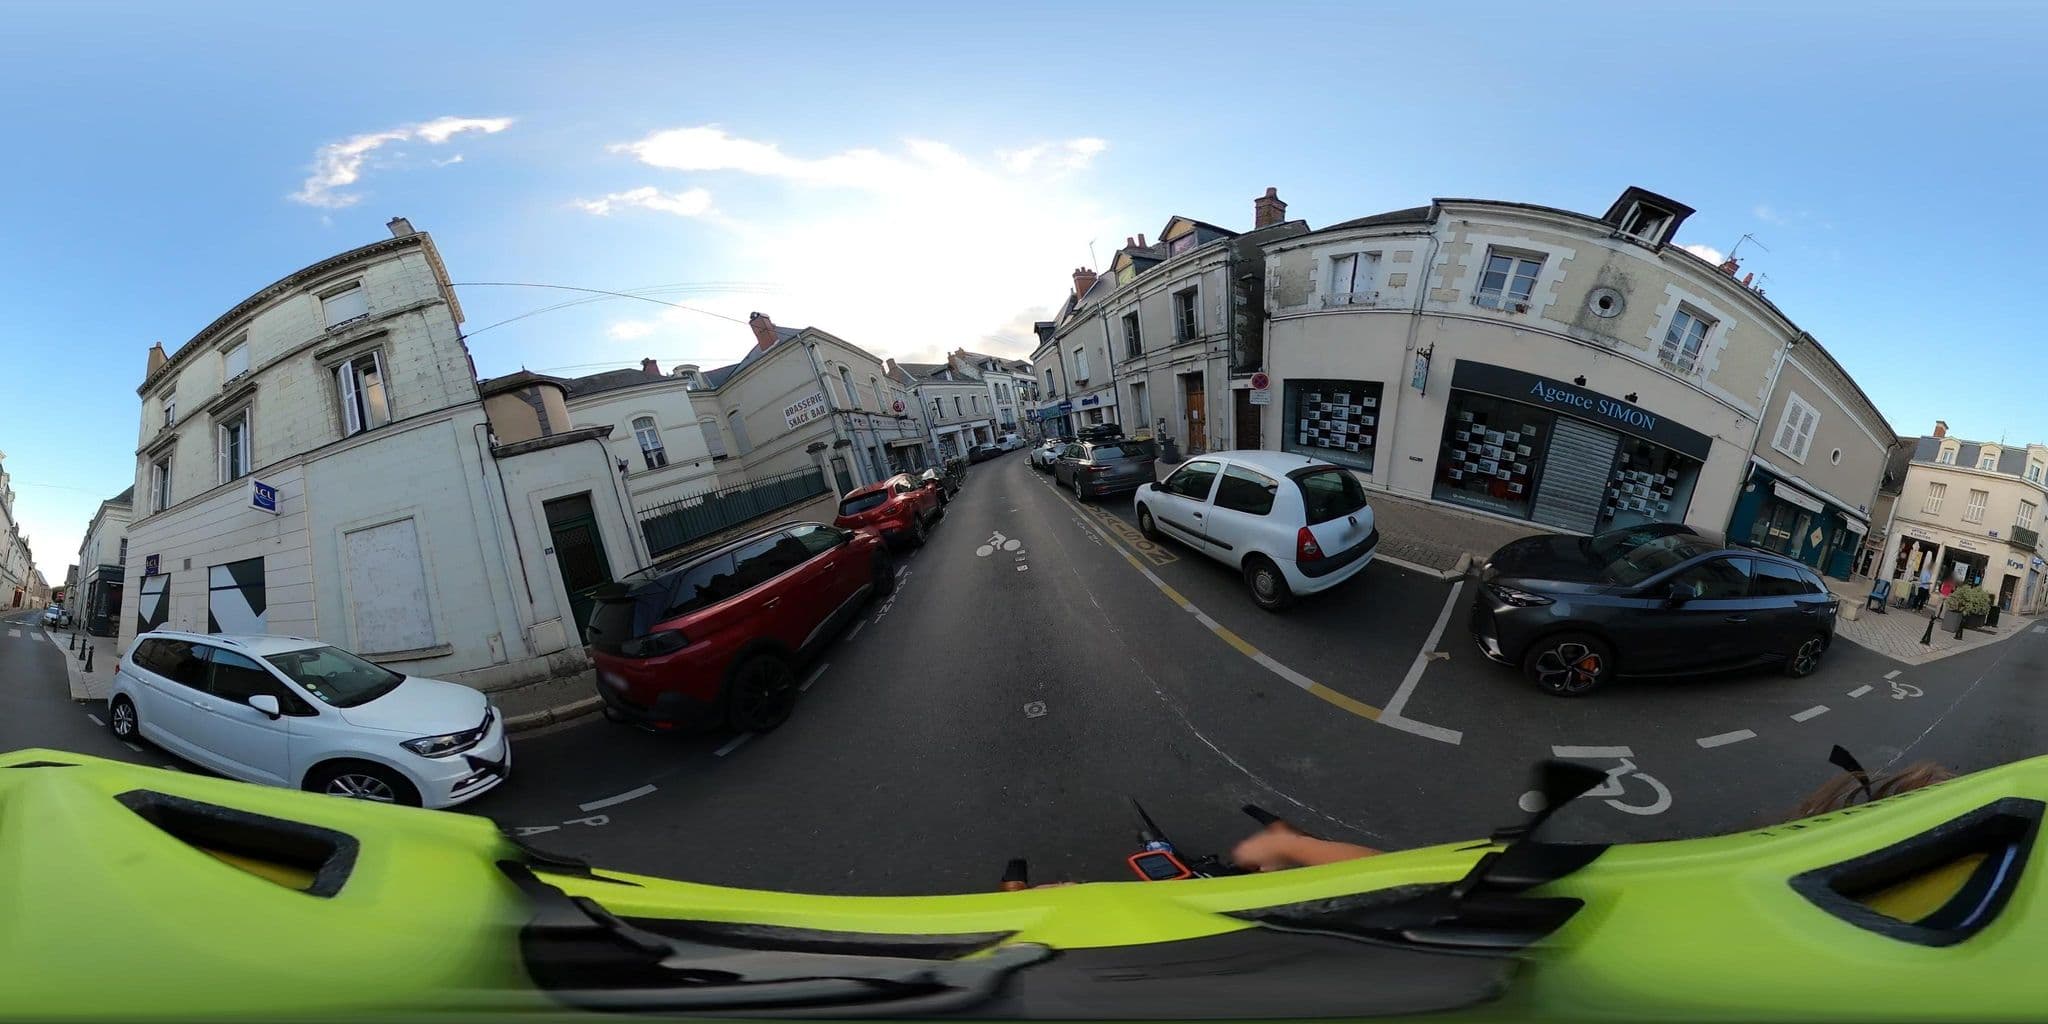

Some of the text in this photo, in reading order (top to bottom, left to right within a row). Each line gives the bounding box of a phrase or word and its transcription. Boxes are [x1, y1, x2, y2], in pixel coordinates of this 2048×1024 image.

[785, 392, 823, 417] BRASSERIE
[1530, 381, 1656, 431] Agence SIMON
[789, 405, 826, 429] SNACK BAR
[255, 486, 273, 500] LCL
